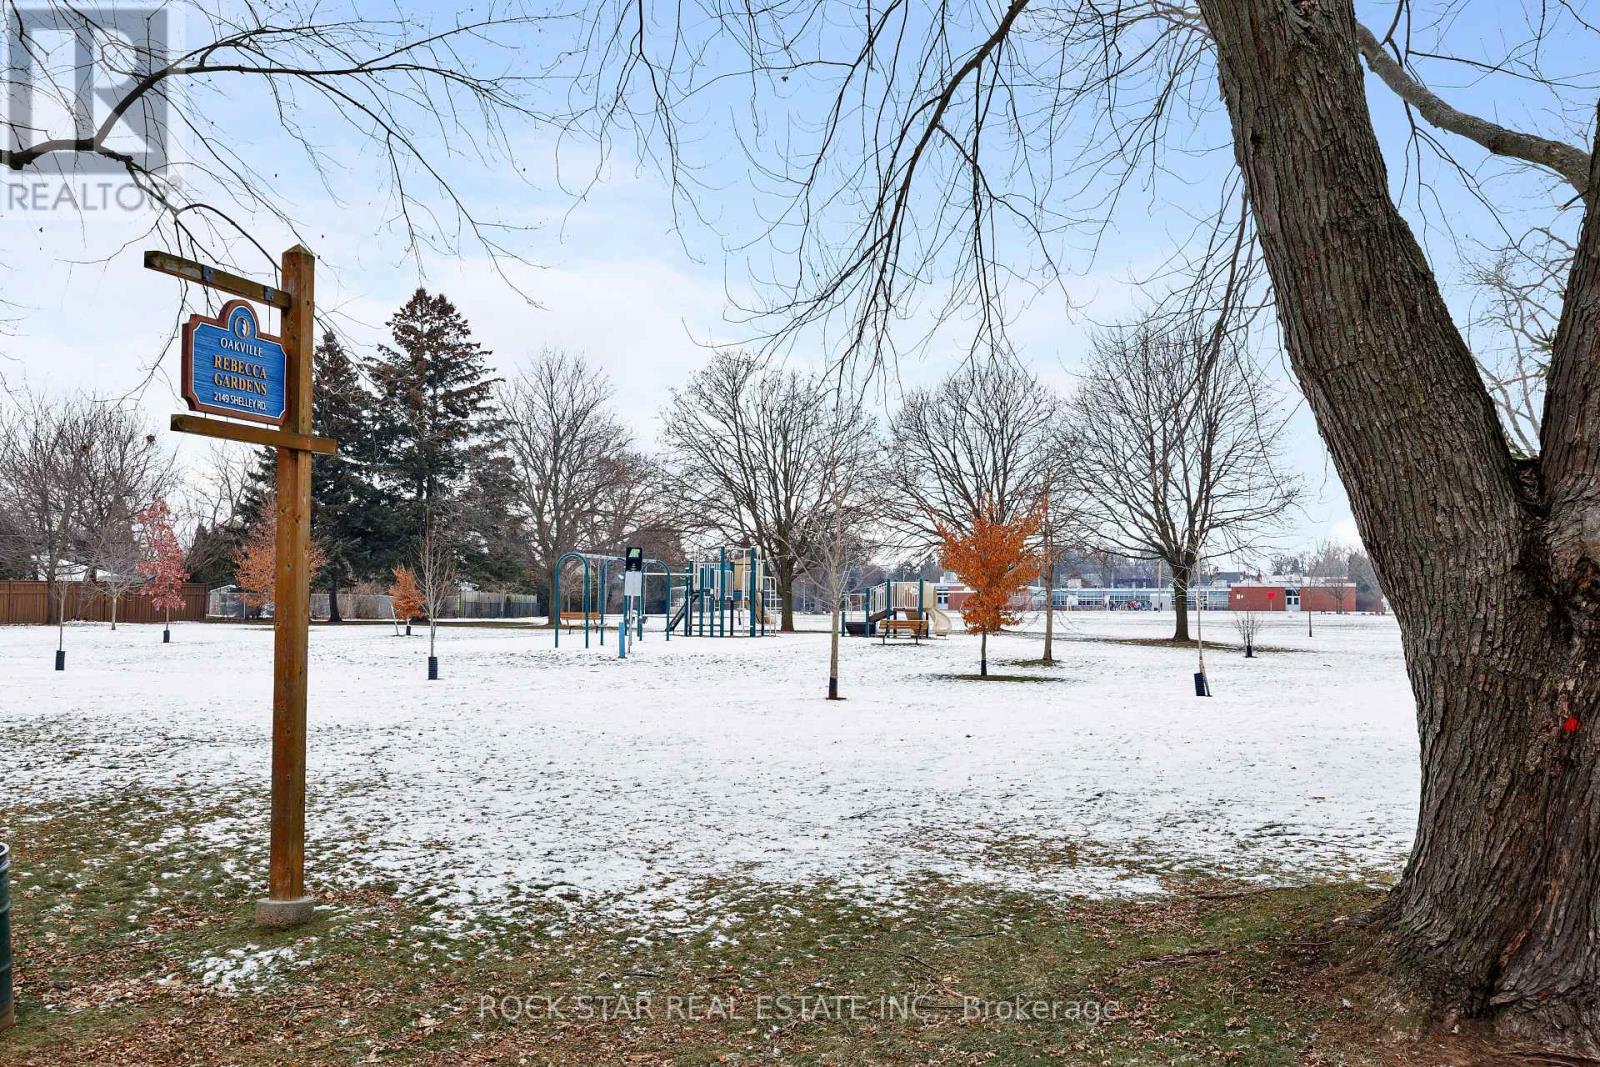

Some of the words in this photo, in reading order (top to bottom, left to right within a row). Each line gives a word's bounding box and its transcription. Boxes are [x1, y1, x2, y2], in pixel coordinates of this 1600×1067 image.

[220, 337, 263, 357] OAKVILLE
[214, 354, 267, 379] REBECCA
[214, 372, 267, 395] GARDENS
[214, 391, 229, 403] 2149
[230, 394, 257, 409] SHELLEY
